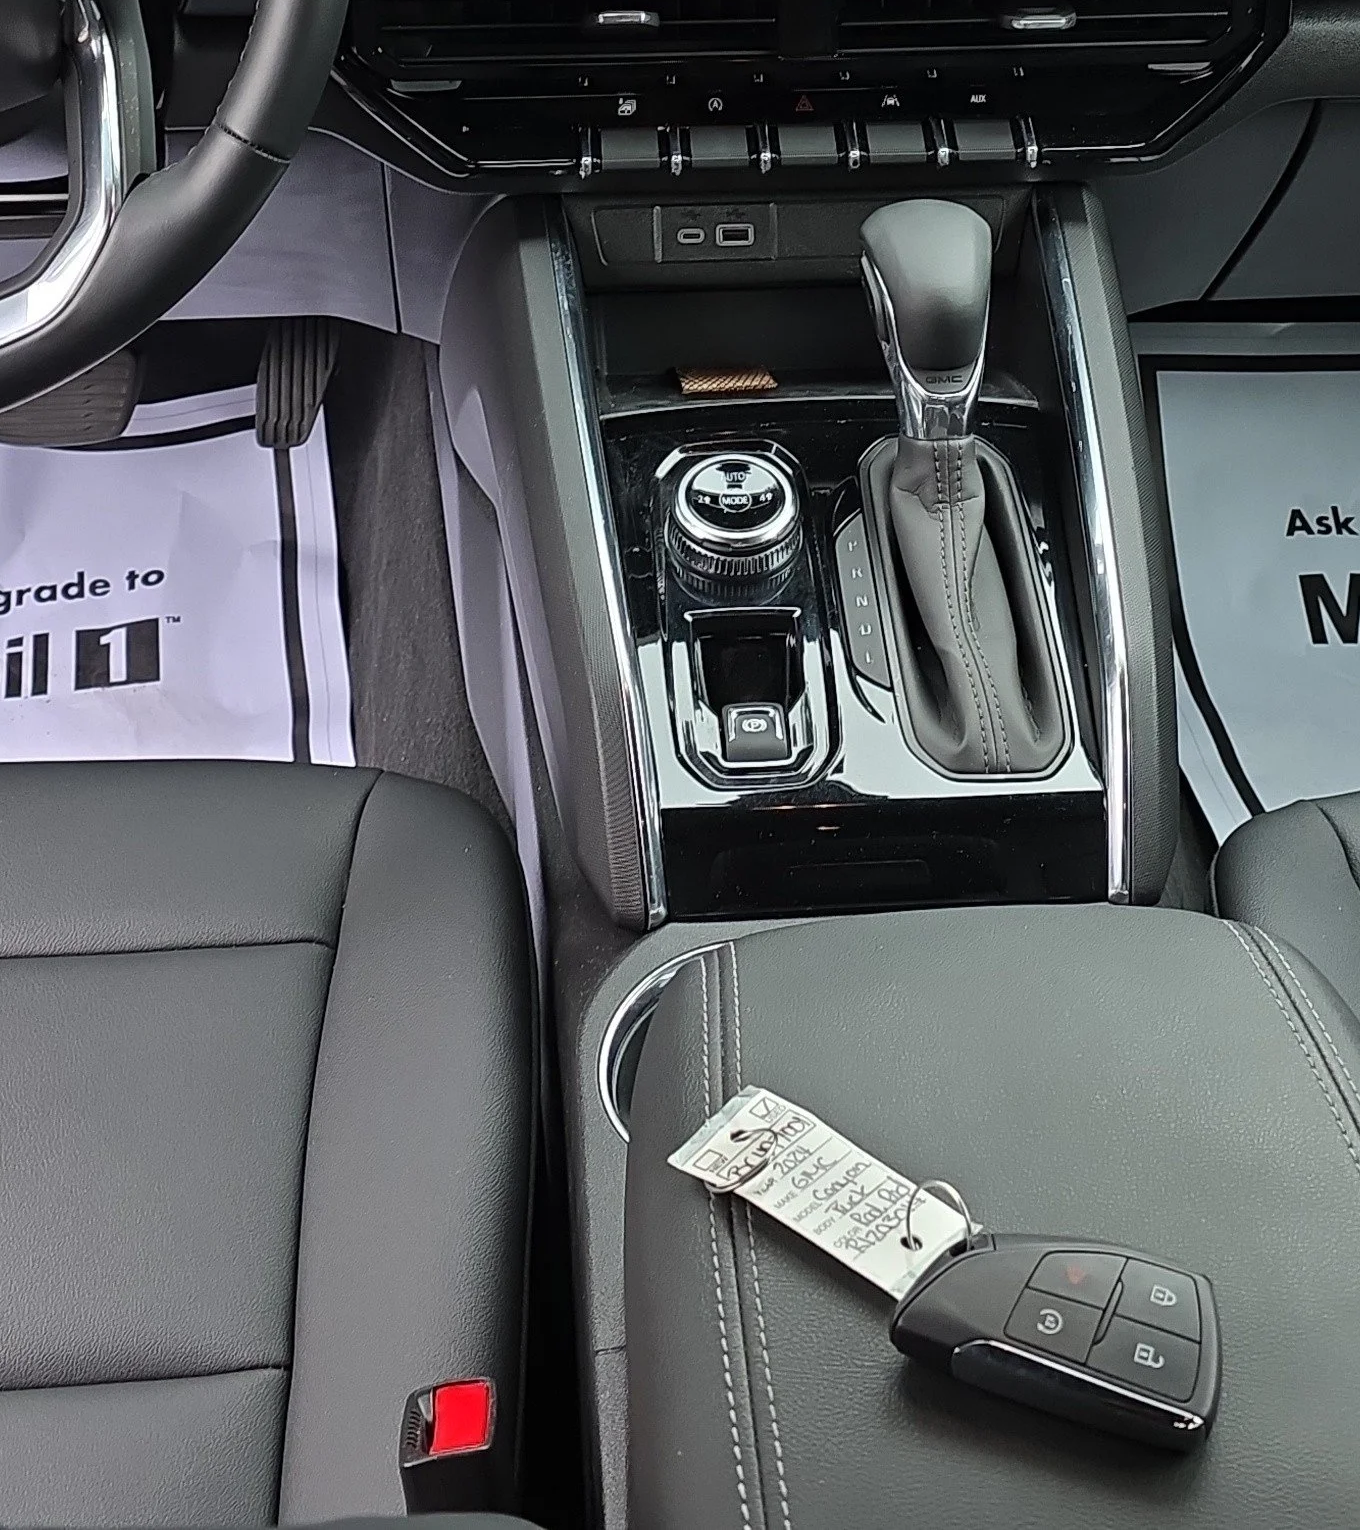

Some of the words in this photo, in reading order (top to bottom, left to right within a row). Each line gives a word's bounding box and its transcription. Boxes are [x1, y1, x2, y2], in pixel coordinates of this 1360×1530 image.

[970, 94, 986, 103] AUX
[925, 375, 963, 384] GMC
[722, 496, 749, 505] MODE
[1285, 506, 1359, 537] Ask
[125, 566, 166, 591] to
[856, 595, 869, 607] N
[773, 1145, 812, 1175] 2024
[774, 1190, 798, 1209] MAKE
[792, 1156, 837, 1189] GMC
[793, 1201, 822, 1223] MODEL
[813, 1161, 873, 1201] Canyon
[813, 1216, 835, 1235] BODY
